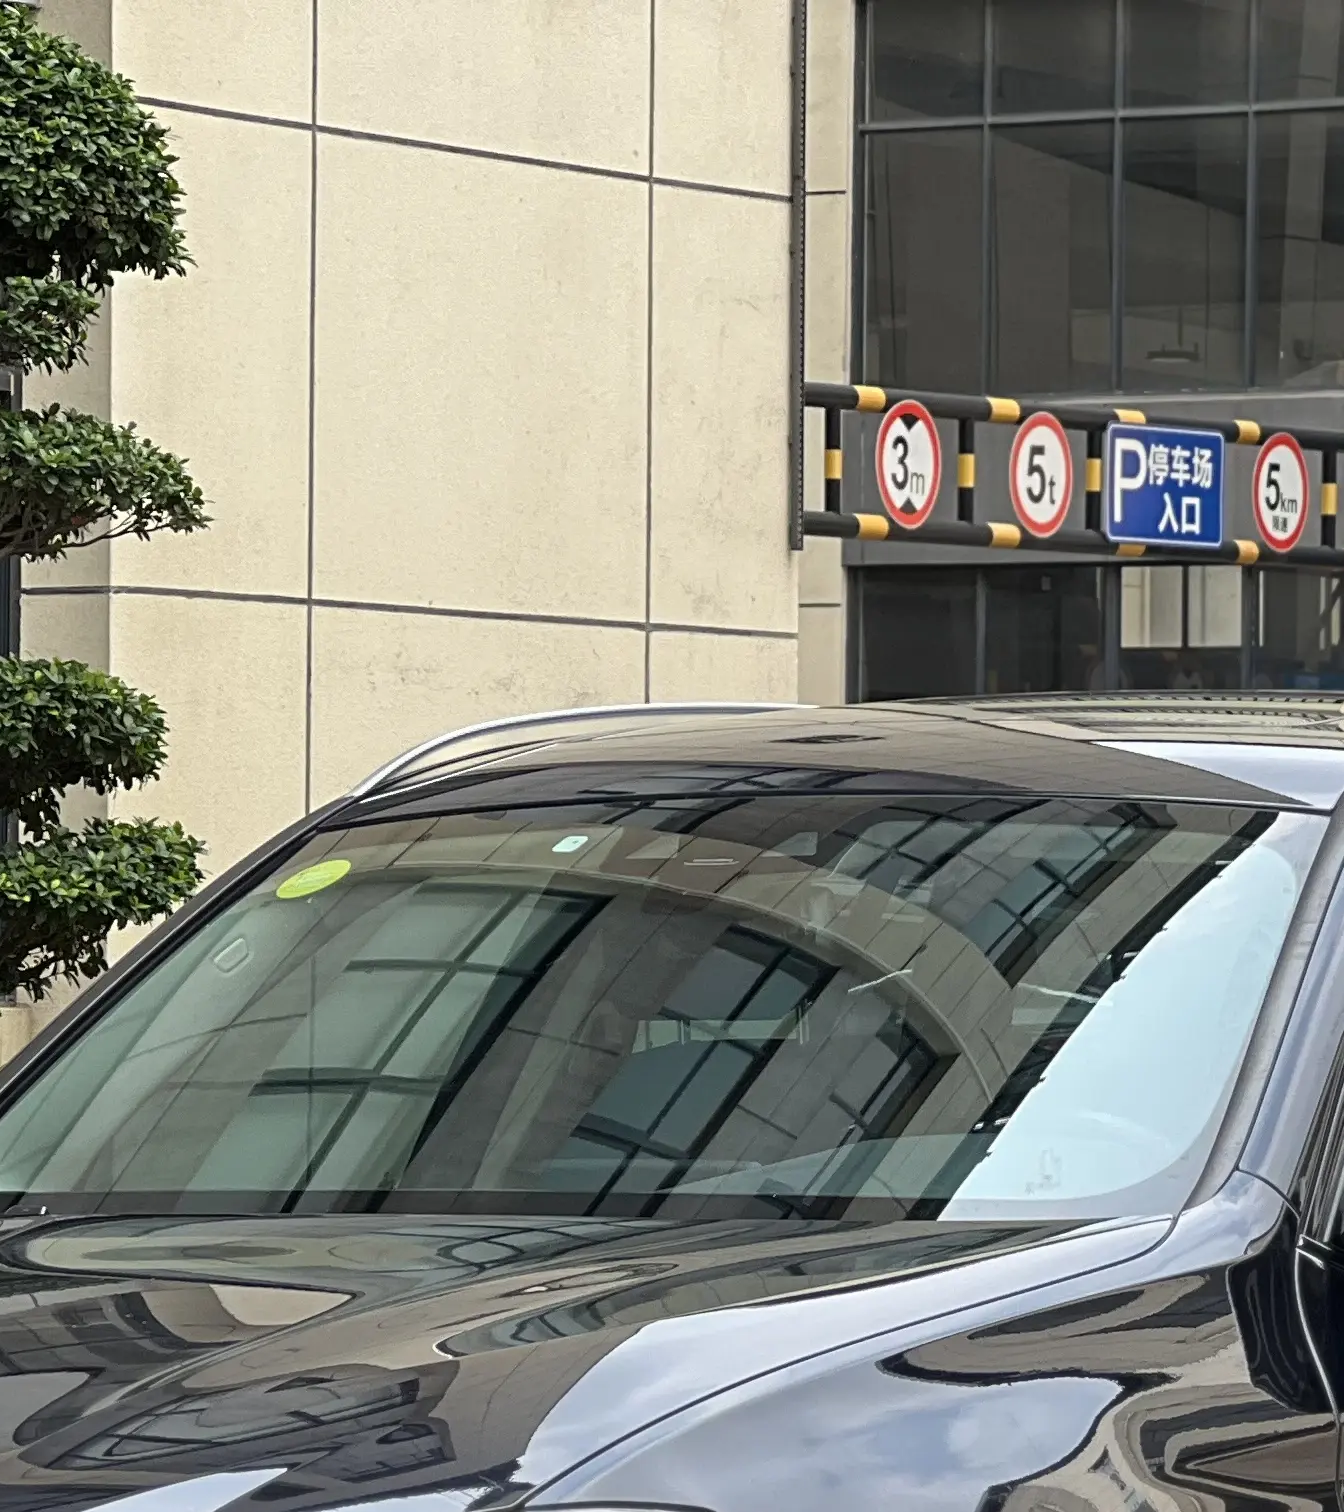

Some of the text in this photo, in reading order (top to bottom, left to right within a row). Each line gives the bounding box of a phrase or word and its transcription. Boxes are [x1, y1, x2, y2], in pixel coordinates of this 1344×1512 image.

[891, 435, 925, 496] 3m
[1026, 445, 1056, 504] 5t
[1113, 437, 1146, 523] P
[1147, 444, 1213, 488] 停车场
[1158, 492, 1201, 535] 入口
